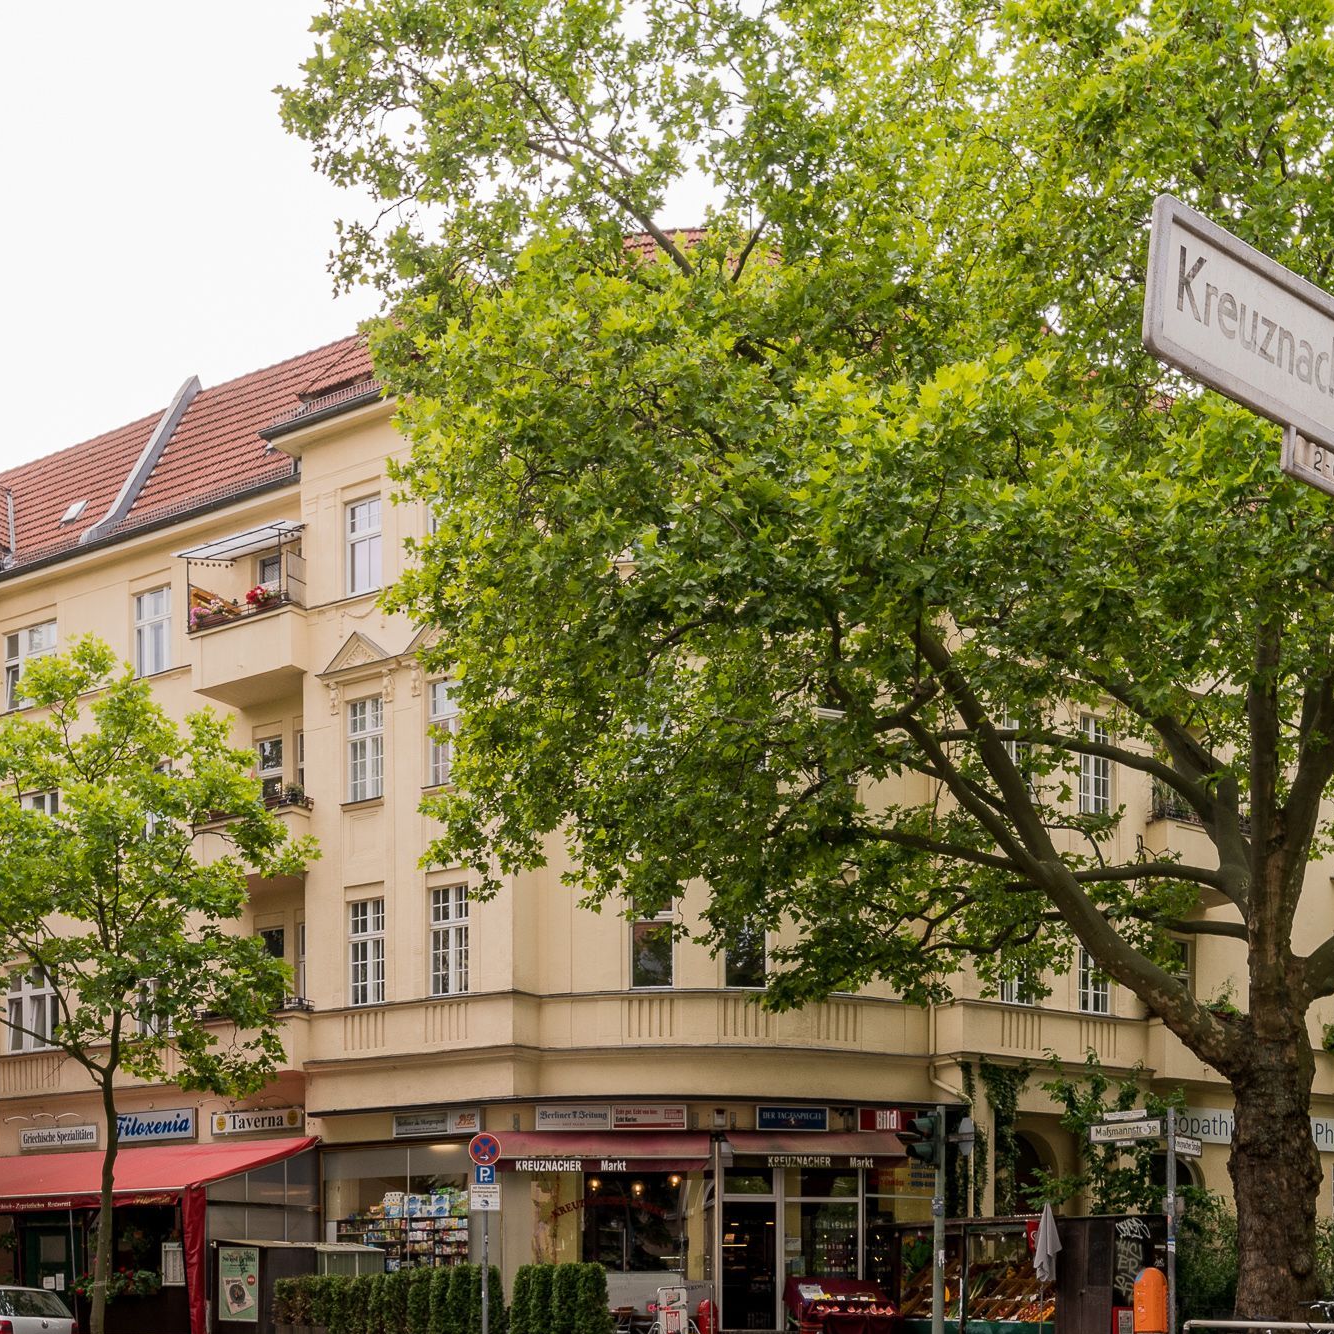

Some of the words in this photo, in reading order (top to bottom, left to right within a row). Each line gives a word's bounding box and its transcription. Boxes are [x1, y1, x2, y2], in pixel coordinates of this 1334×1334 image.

[229, 1114, 284, 1130] Taverna
[539, 1110, 571, 1120] Berliner
[578, 1110, 608, 1121] Zeitung
[762, 1111, 776, 1119] DER
[777, 1111, 822, 1120] TAGESSPIEGEL
[116, 1112, 191, 1139] Filoxenia
[1095, 1123, 1157, 1138] Maßmannstrße
[23, 1130, 56, 1145] Griechische
[56, 1128, 94, 1144] Spezialitäten
[515, 1160, 582, 1172] KREUZNACHER
[600, 1160, 627, 1171] Markt
[767, 1156, 831, 1168] KREUZNACHER
[849, 1156, 874, 1168] Markt
[479, 1166, 491, 1182] P
